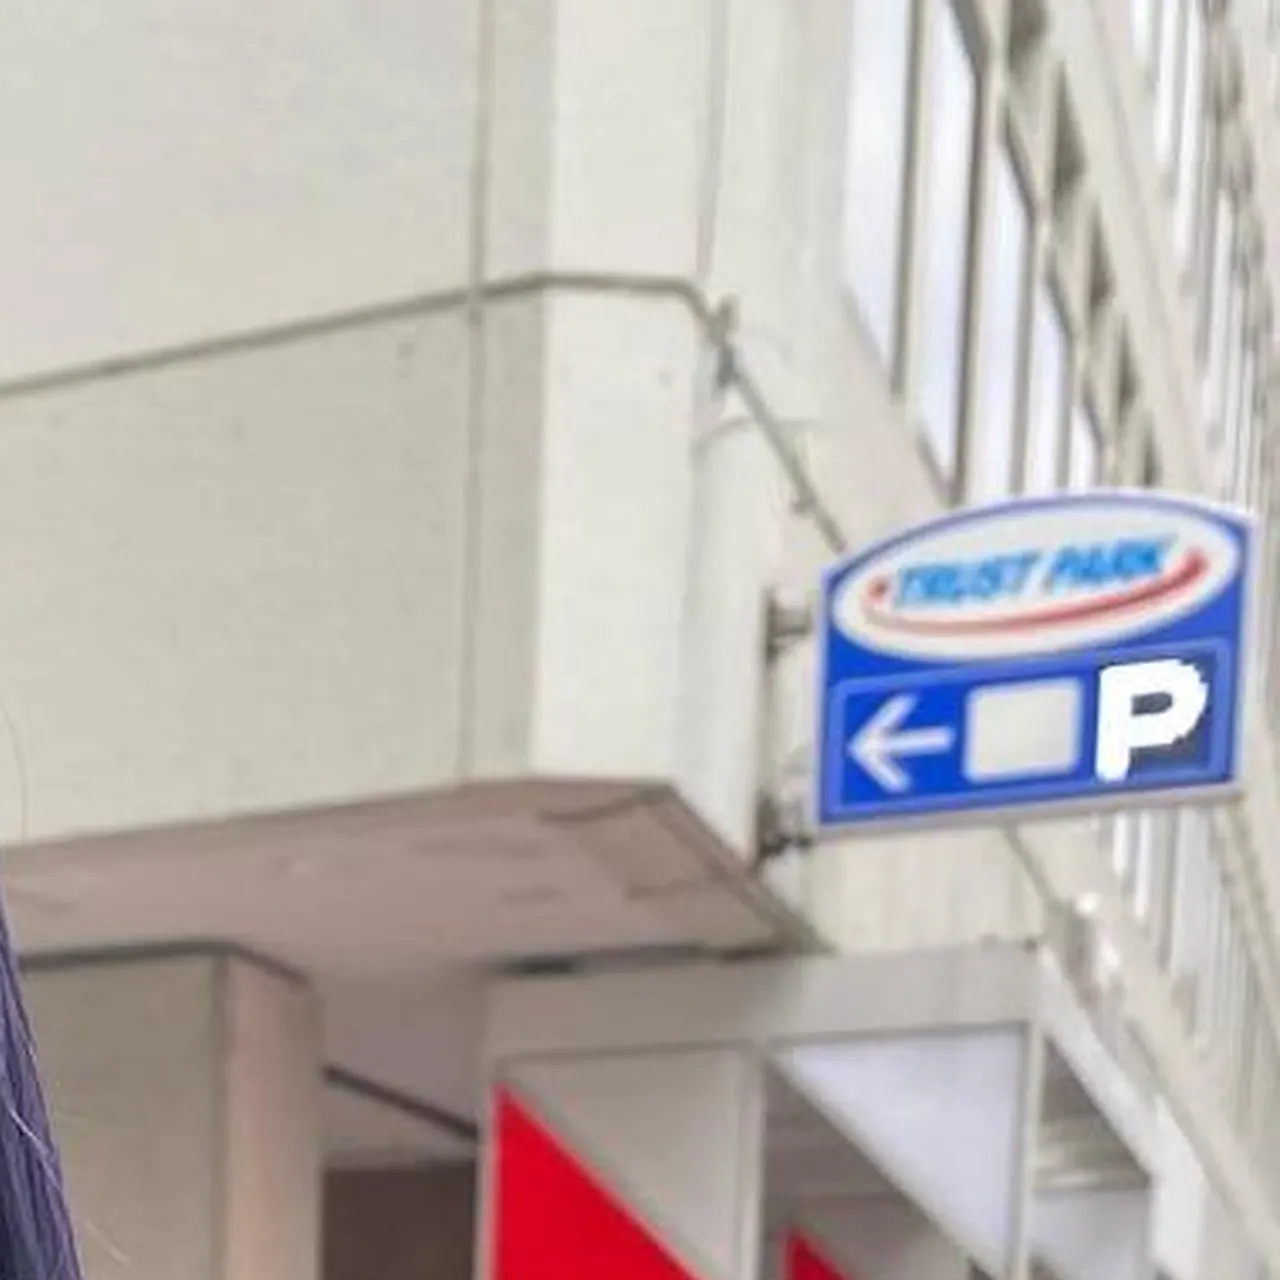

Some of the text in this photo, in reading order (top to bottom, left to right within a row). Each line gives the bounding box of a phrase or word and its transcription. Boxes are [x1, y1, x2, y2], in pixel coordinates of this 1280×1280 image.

[895, 533, 1177, 609] TRUST PARK
[1096, 658, 1208, 782] P
